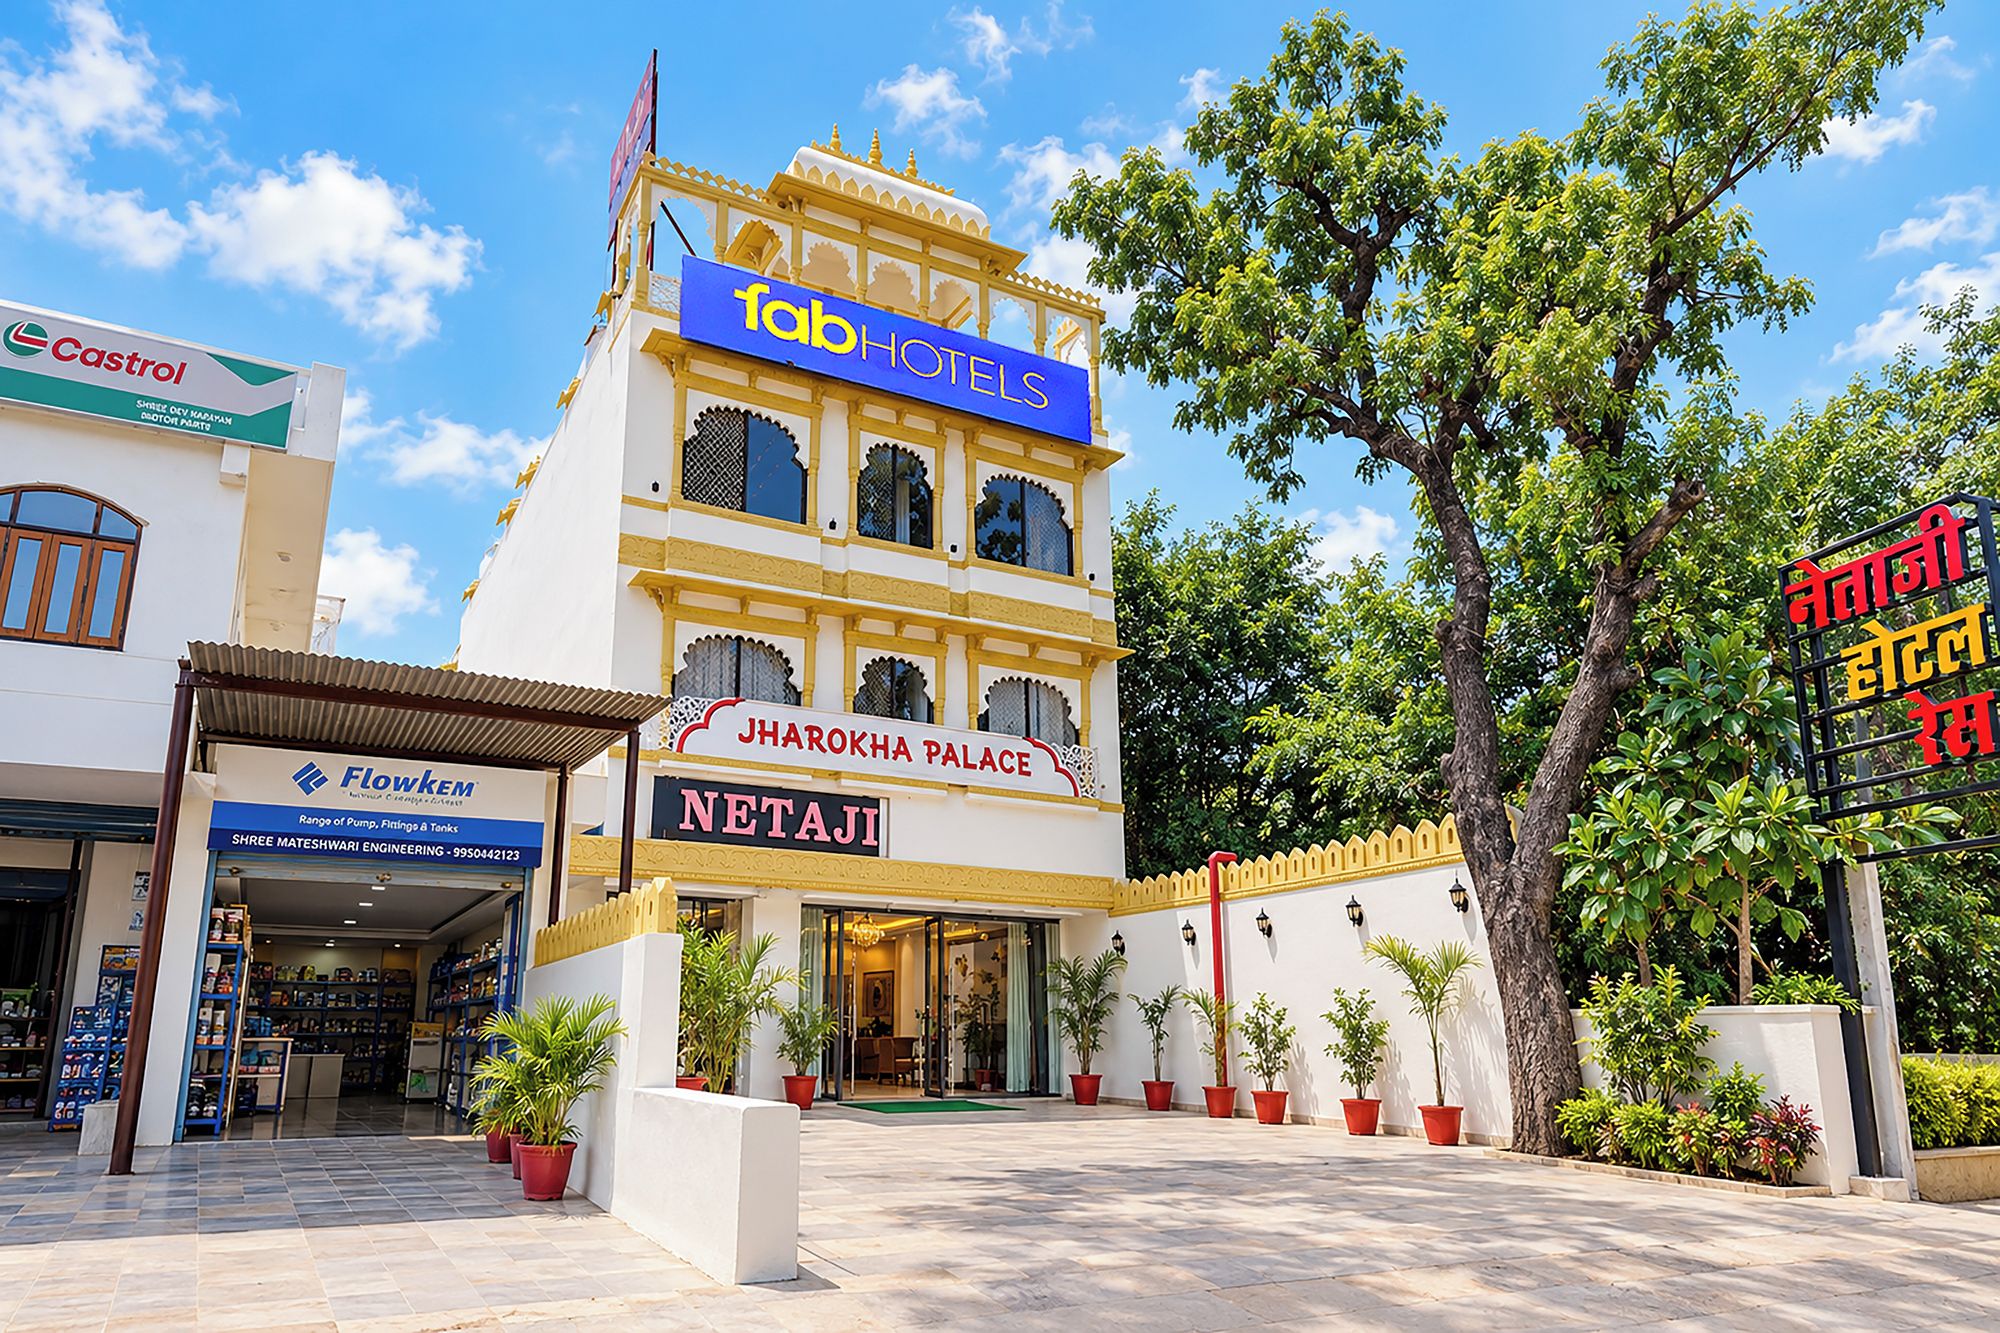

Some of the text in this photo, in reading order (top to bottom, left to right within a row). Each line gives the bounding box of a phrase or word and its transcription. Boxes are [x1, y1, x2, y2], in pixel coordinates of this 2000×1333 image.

[51, 337, 187, 385] Castrol
[1784, 503, 1965, 629] नेताजी
[1839, 602, 1986, 701] होटल
[737, 716, 1033, 777] JHAROKHA PALACE
[232, 834, 274, 847] SHREE
[277, 837, 360, 851] MATESHWARI
[363, 841, 444, 857] ENGINEERING
[299, 814, 332, 828] Range
[333, 816, 346, 826] of
[430, 823, 459, 833] Tanks
[679, 788, 879, 847] NETAJI
